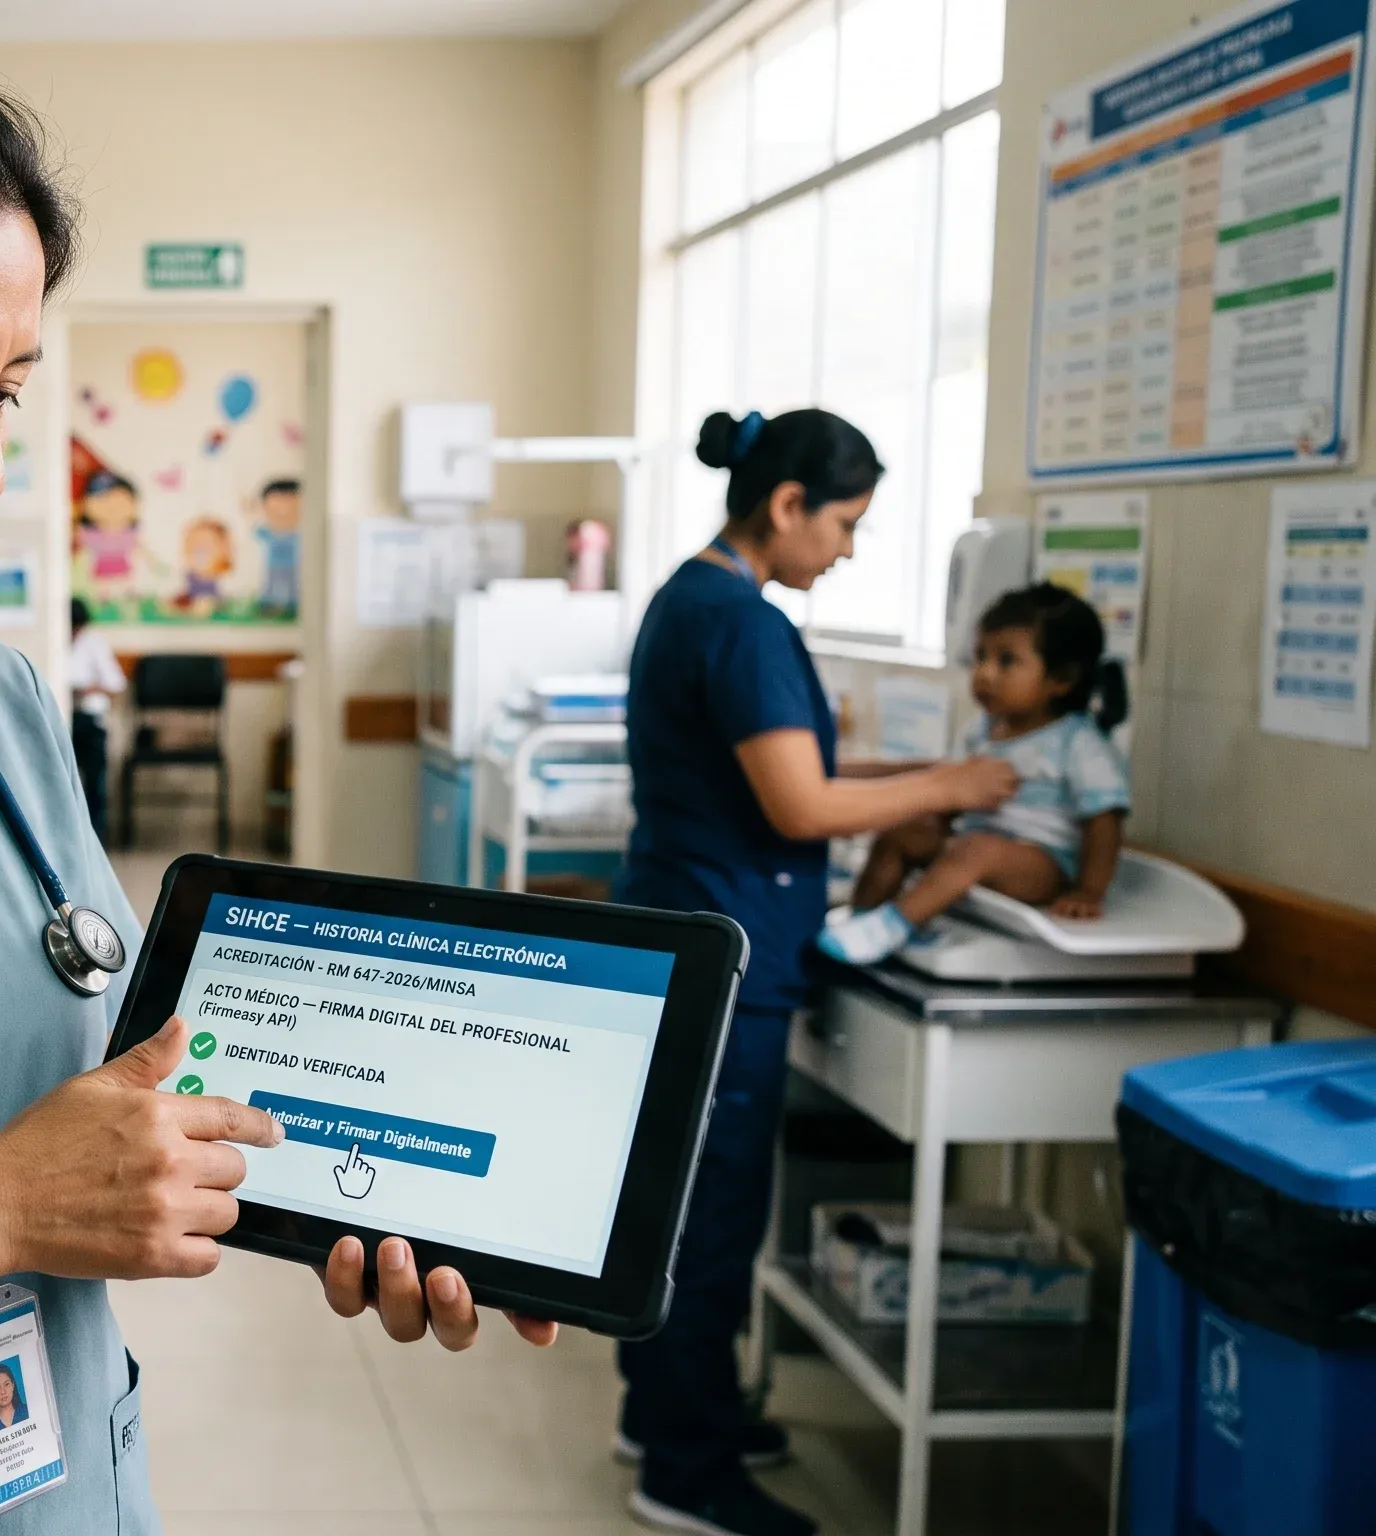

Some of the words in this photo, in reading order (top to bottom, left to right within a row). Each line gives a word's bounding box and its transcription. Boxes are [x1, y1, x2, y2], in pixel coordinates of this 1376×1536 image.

[225, 906, 291, 933] SIHCE
[312, 921, 383, 945] HISTORIA
[387, 931, 449, 954] CLÍNICA
[453, 940, 567, 970] ELECTRÓNICA
[212, 946, 316, 973] ACREDITACIÓN
[326, 962, 351, 978] RM
[353, 967, 476, 997] 647-2026/MINSA
[198, 1000, 265, 1026] (Firmeasy
[267, 1012, 298, 1031] API)
[203, 982, 242, 1000] ACTO
[244, 988, 300, 1009] MÉDICO
[318, 1000, 364, 1021] FIRMA
[368, 1008, 425, 1030] DIGITAL
[429, 1017, 457, 1035] DEL
[462, 1023, 571, 1053] PROFESIONAL
[224, 1044, 299, 1068] IDENTIDAD
[303, 1057, 386, 1084] VERIFICADA
[324, 1121, 335, 1136] y
[336, 1120, 381, 1142] Firmar
[383, 1130, 472, 1159] Digitalmente
